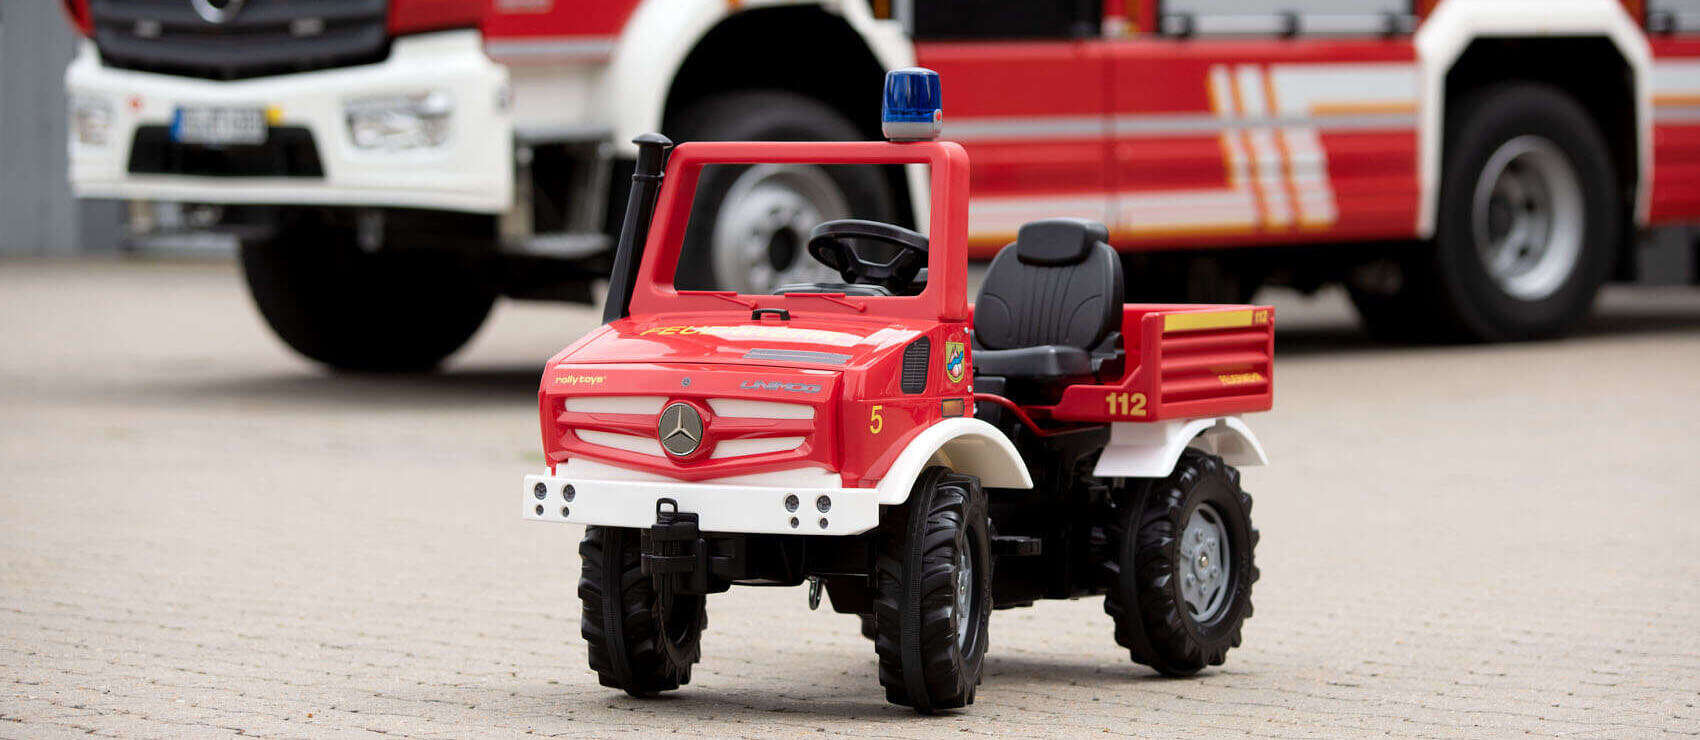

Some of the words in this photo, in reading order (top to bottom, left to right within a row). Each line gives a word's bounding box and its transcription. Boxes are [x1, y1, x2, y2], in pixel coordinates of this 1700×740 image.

[555, 375, 578, 386] rolly
[1105, 392, 1147, 416] 112
[870, 405, 883, 434] 5
